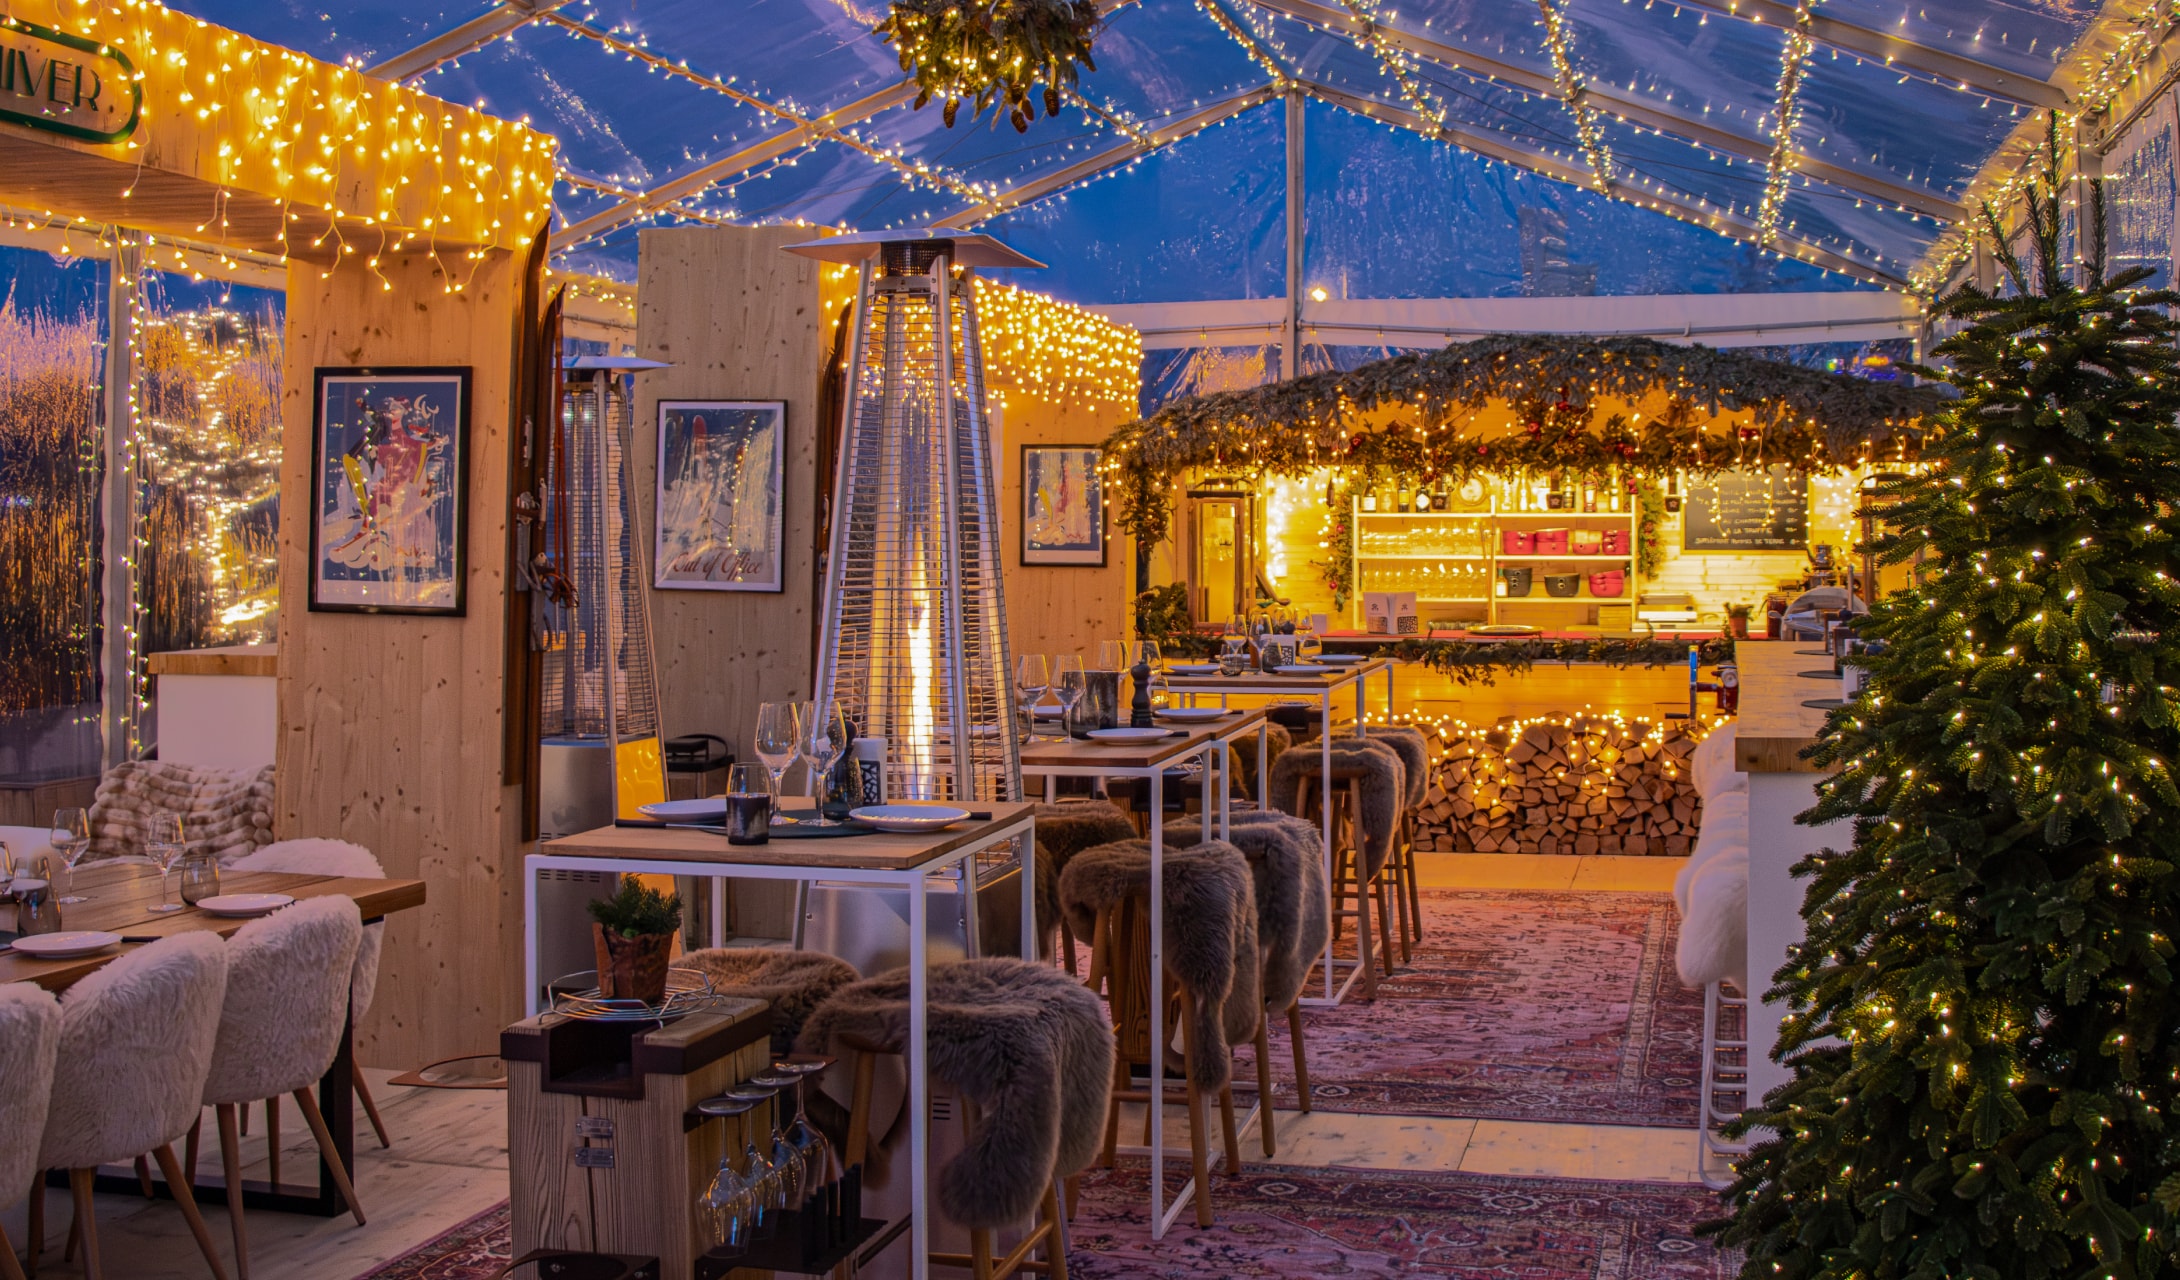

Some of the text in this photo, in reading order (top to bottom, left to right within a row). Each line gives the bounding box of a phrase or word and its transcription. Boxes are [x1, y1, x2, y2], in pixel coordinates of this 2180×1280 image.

[0, 46, 101, 111] IVER
[673, 551, 762, 581] Out of Office
